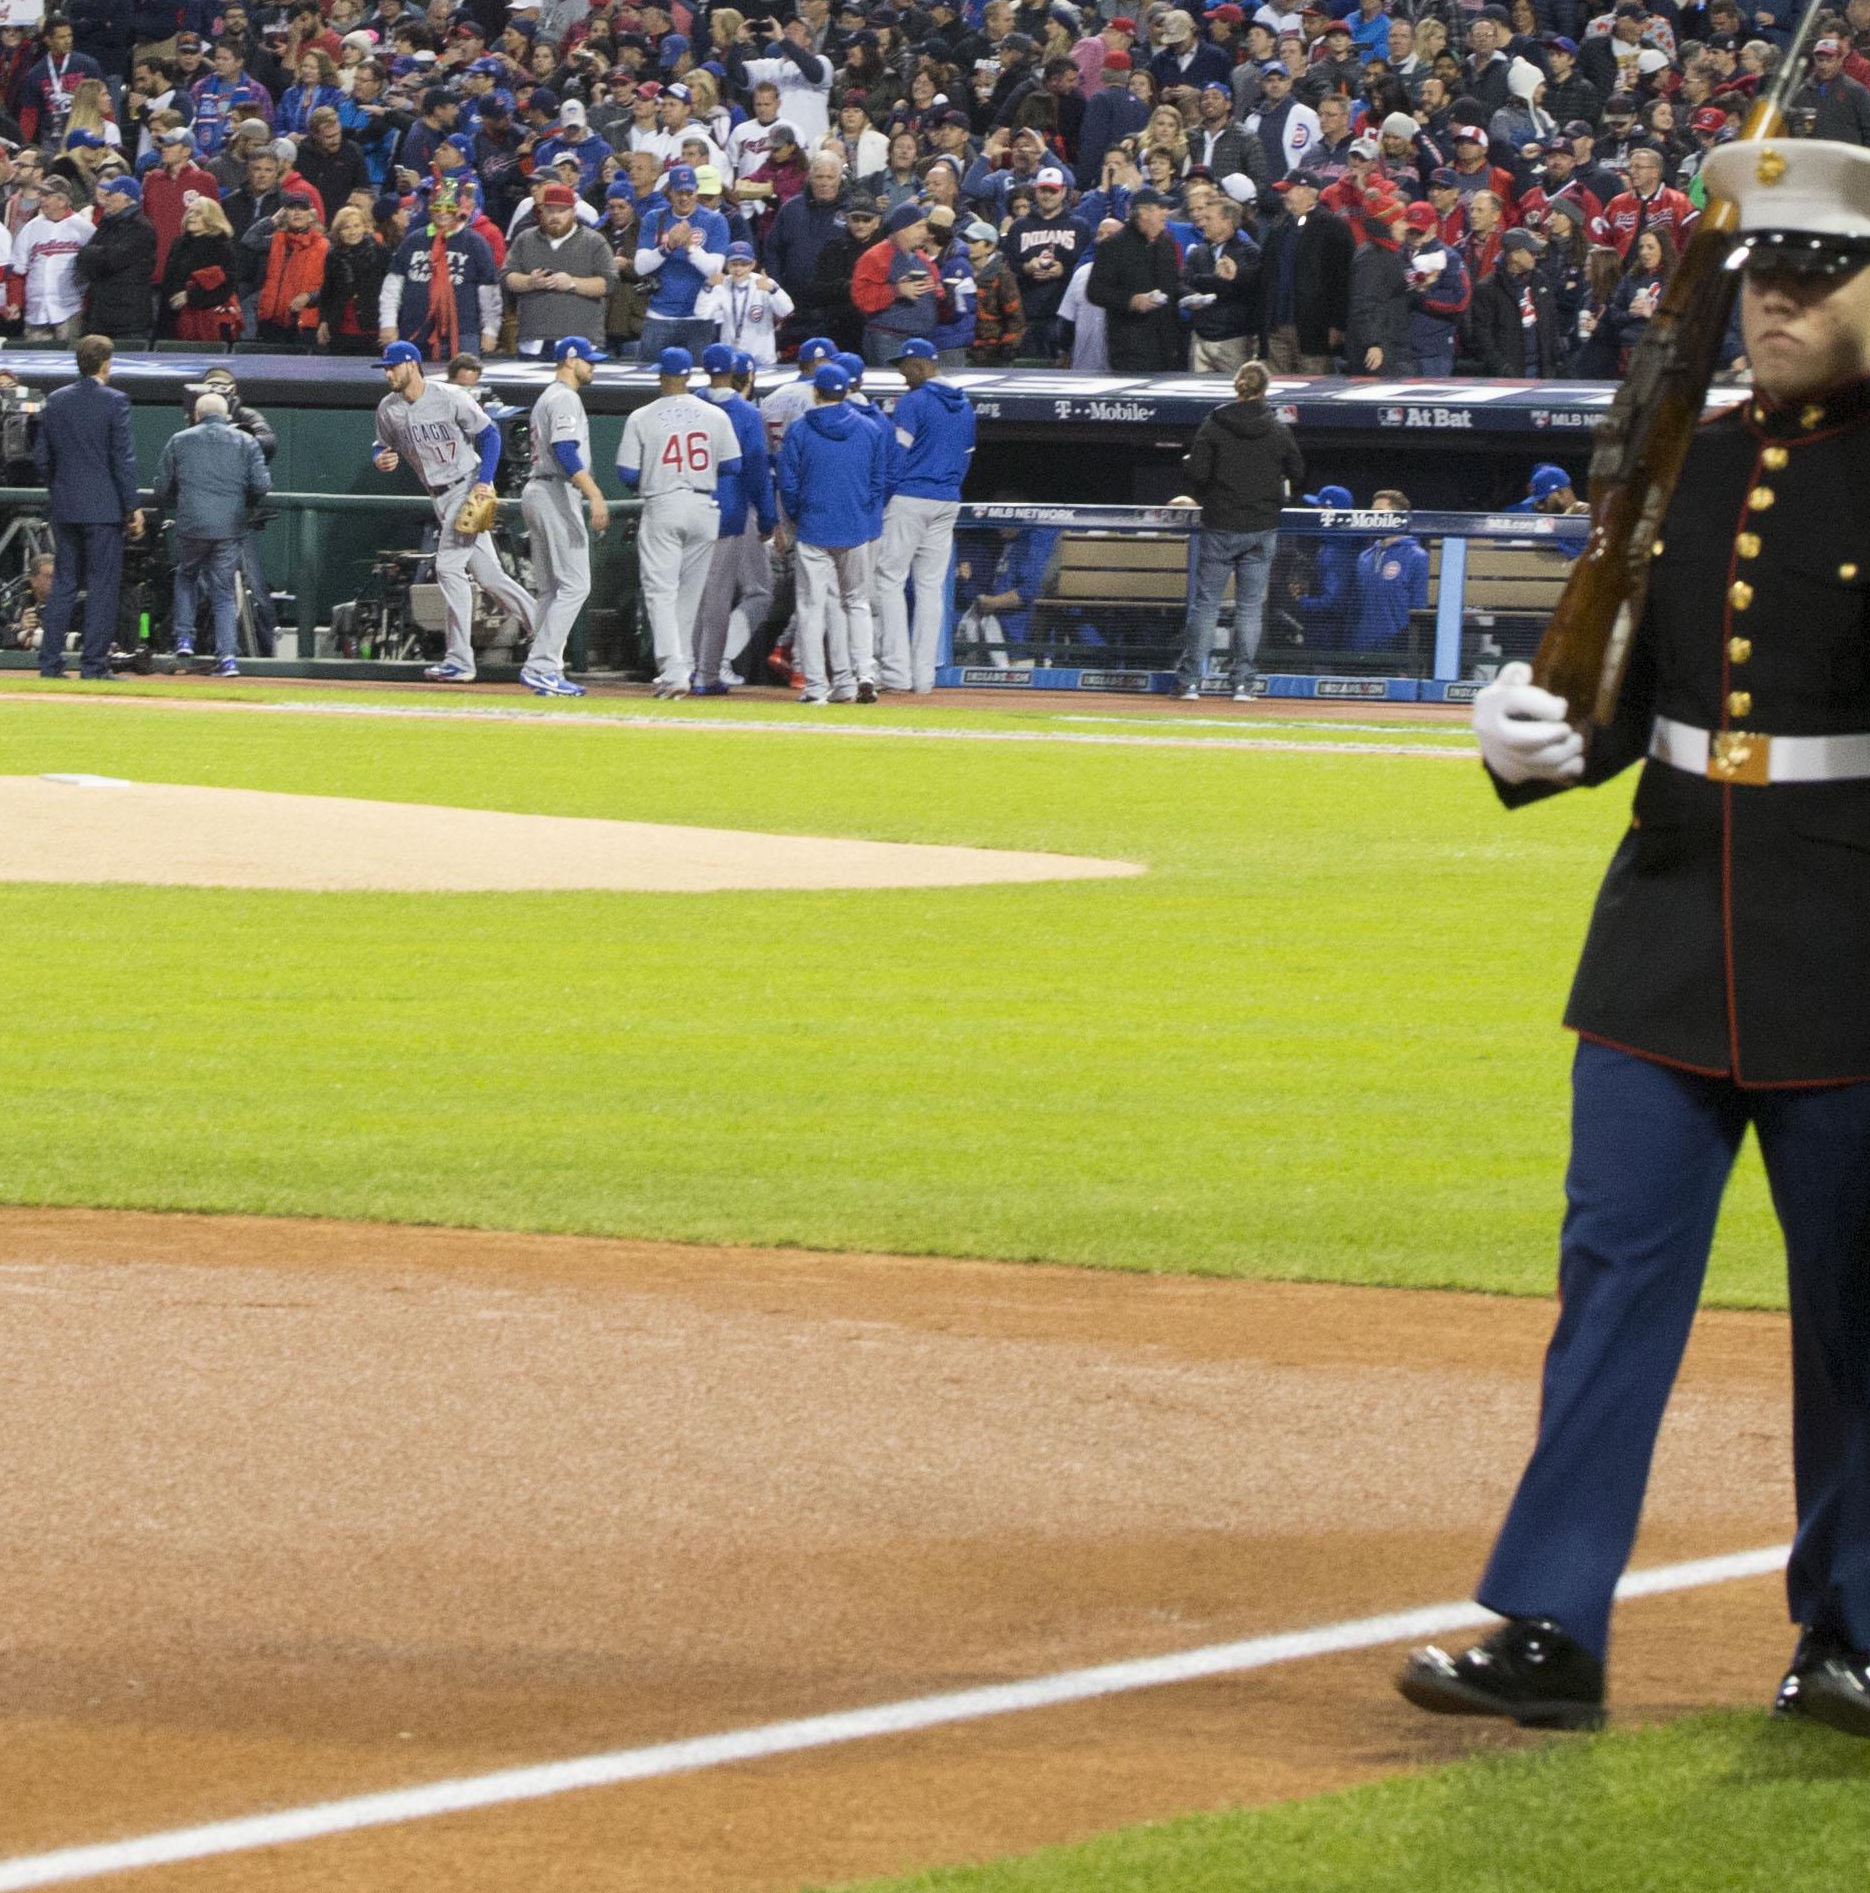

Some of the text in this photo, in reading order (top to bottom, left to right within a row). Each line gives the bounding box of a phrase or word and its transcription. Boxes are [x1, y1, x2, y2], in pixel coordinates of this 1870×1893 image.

[1017, 229, 1072, 251] INDIANS
[409, 251, 468, 266] PATY
[1405, 407, 1471, 427] At Bat
[433, 441, 457, 464] 17
[661, 431, 709, 473] 46
[987, 506, 1076, 522] MLB NETWORK
